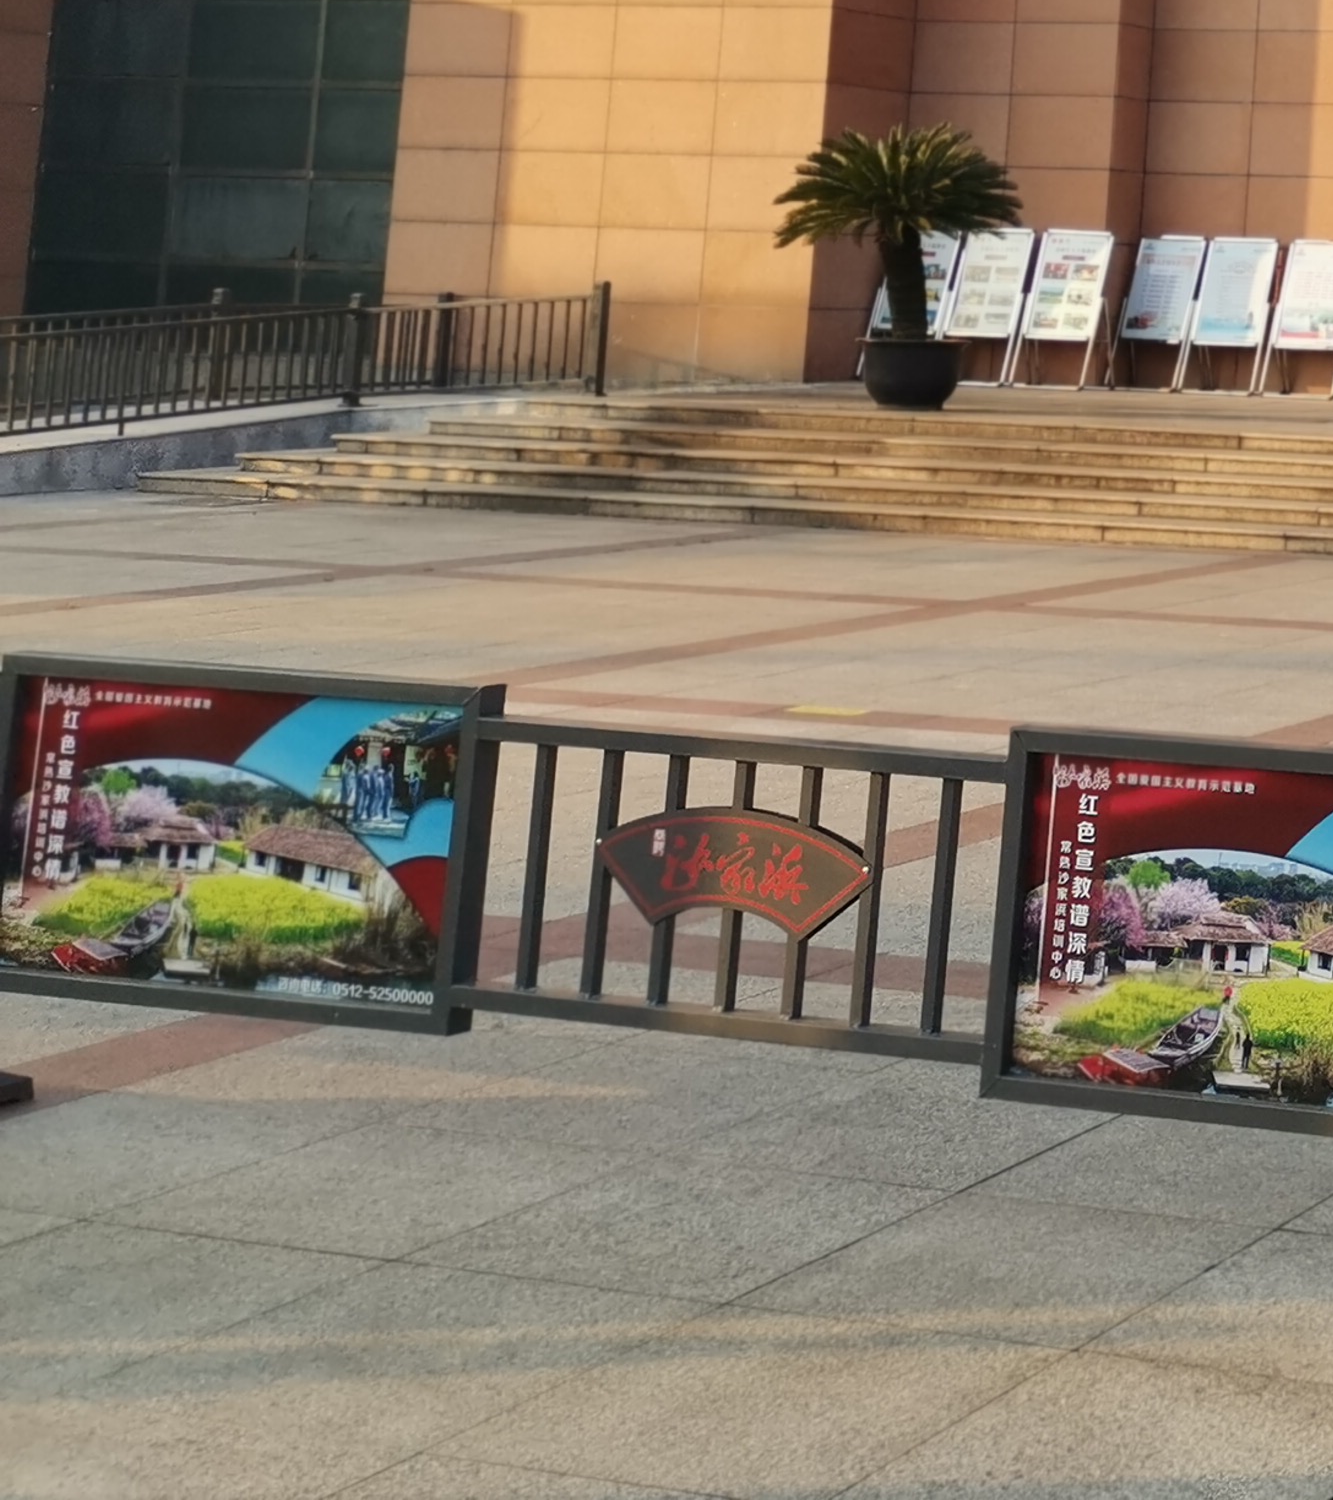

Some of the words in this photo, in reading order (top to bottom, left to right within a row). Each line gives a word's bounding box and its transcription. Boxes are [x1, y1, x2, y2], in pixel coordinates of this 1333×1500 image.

[1115, 772, 1256, 795] 全国爱国主义教育示范基地
[1049, 840, 1073, 981] 常熟沙家浜培训中心
[1064, 793, 1099, 985] 红色宣教谱深情
